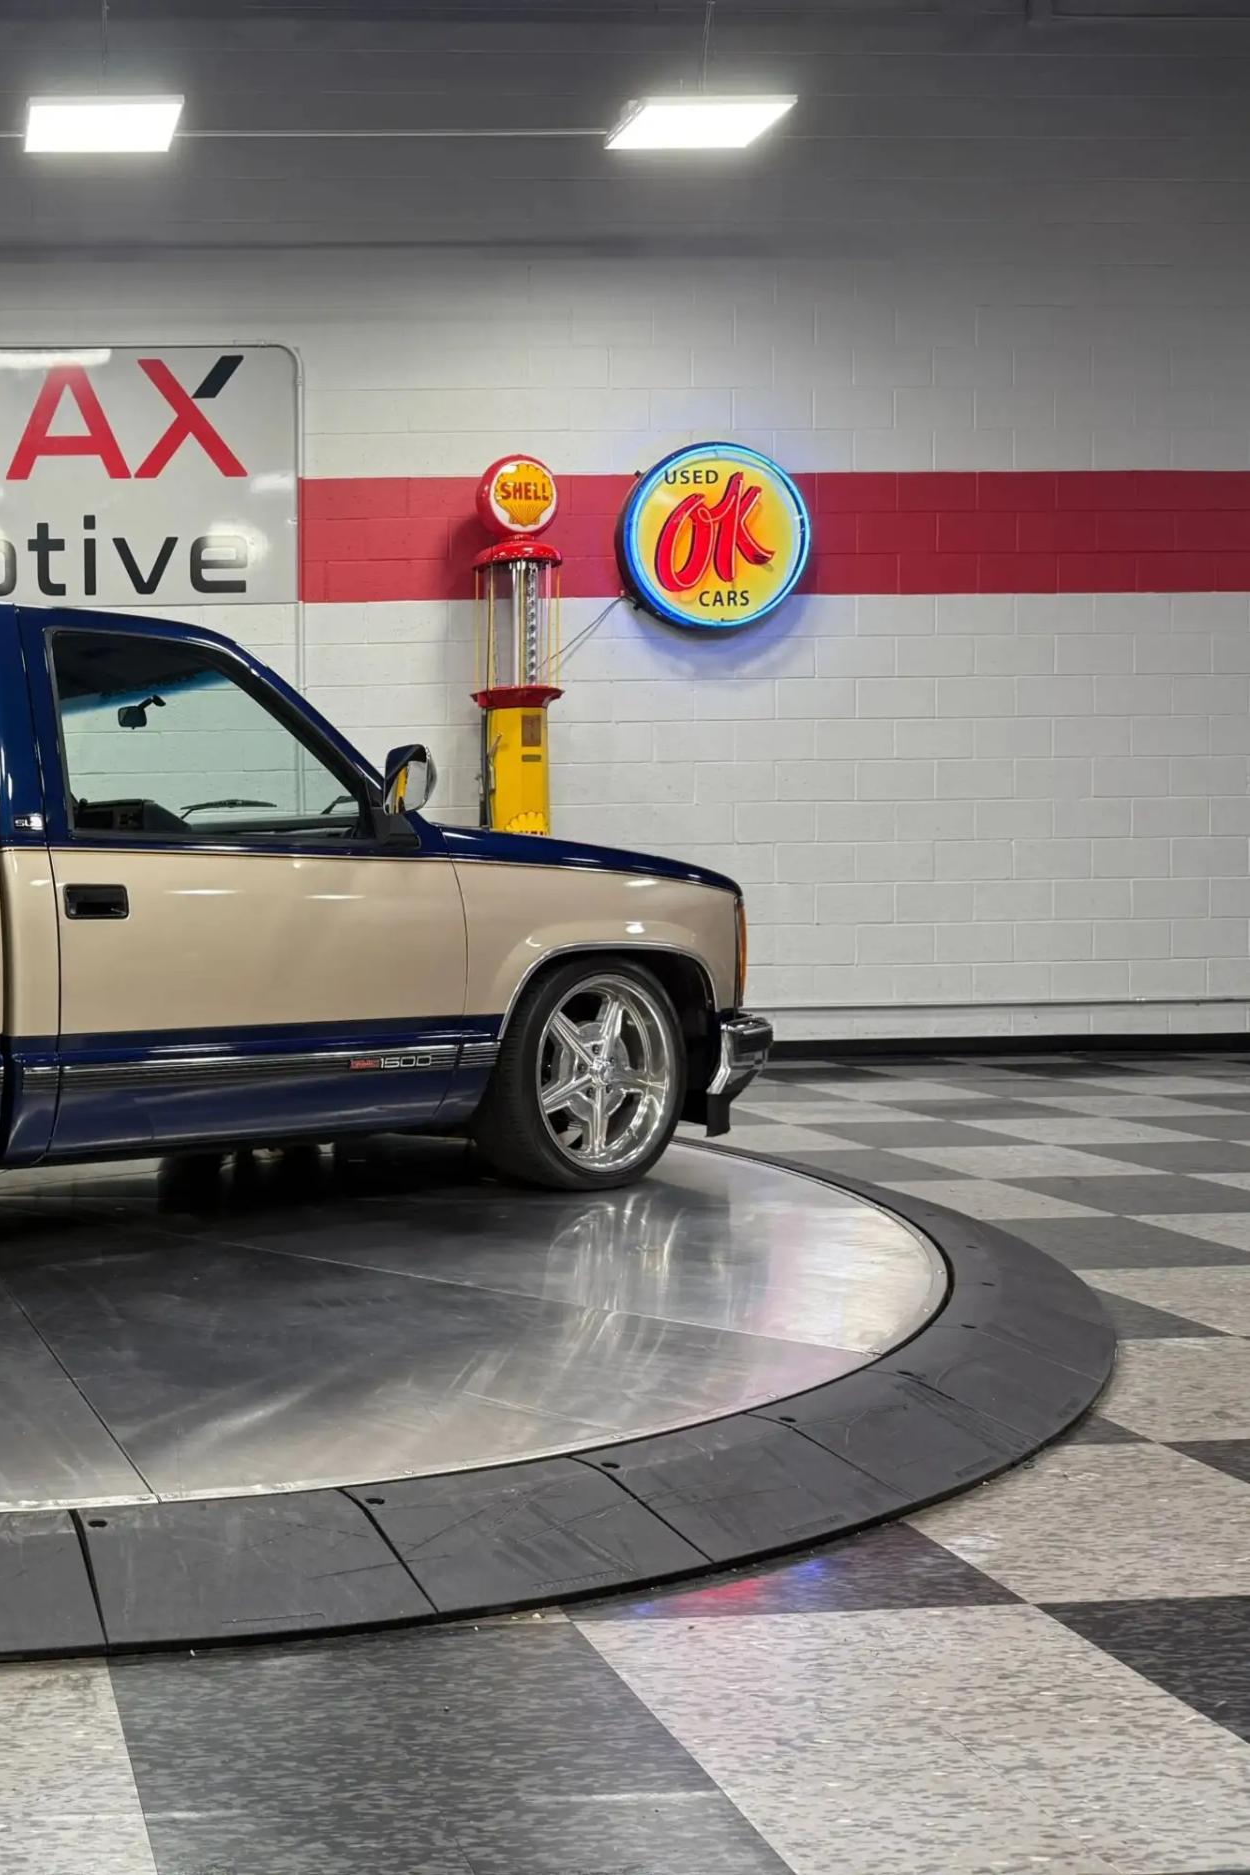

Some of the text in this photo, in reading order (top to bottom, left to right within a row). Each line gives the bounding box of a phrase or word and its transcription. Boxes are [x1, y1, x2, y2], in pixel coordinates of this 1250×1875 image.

[664, 469, 719, 485] USED
[499, 481, 550, 502] SHELL
[698, 590, 750, 607] CARS
[380, 1055, 432, 1069] 1500
